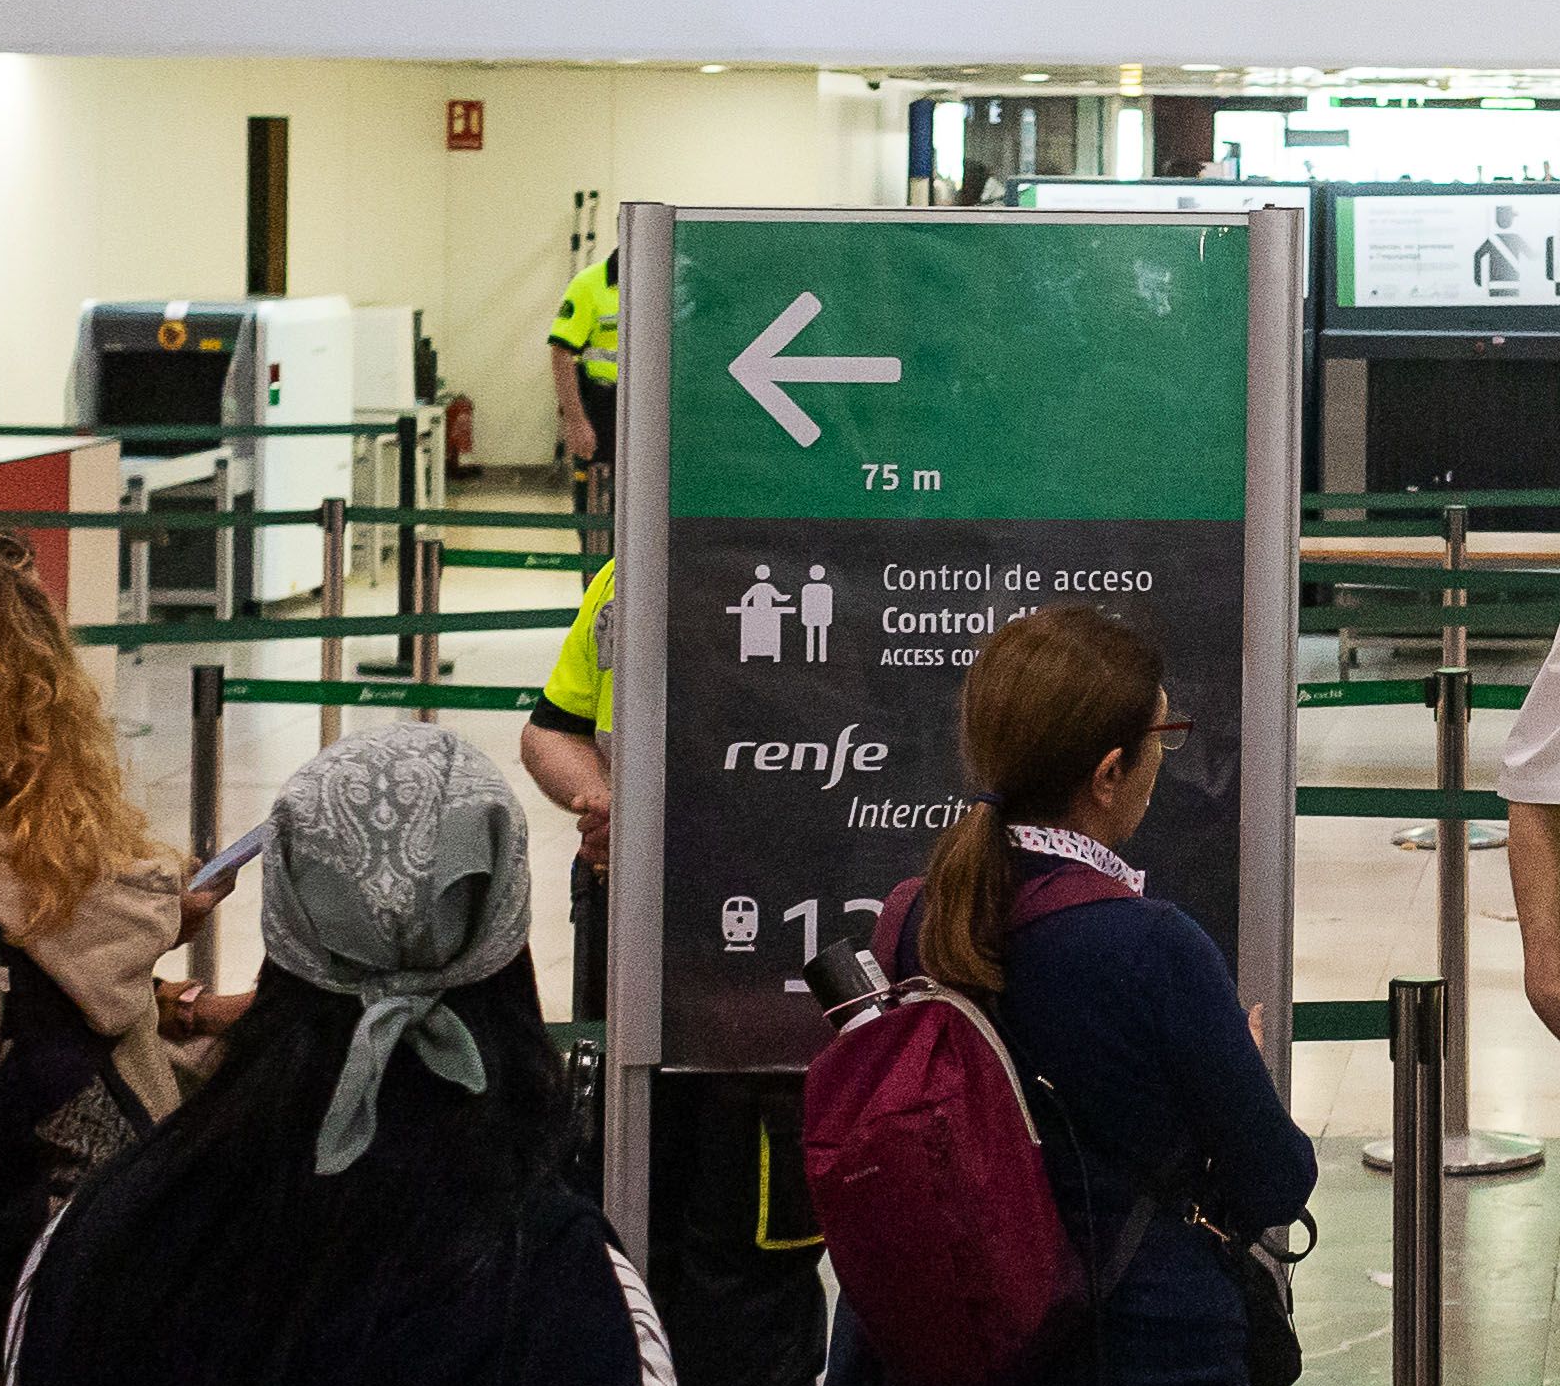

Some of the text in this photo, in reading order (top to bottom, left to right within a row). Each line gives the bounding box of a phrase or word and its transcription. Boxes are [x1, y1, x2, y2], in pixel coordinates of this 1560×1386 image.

[860, 463, 942, 491] 75 m
[883, 563, 1154, 592] Control de acceso
[881, 606, 995, 634] Control
[880, 648, 944, 666] ACCESS
[723, 723, 889, 790] renfe
[847, 795, 973, 828] Intercit
